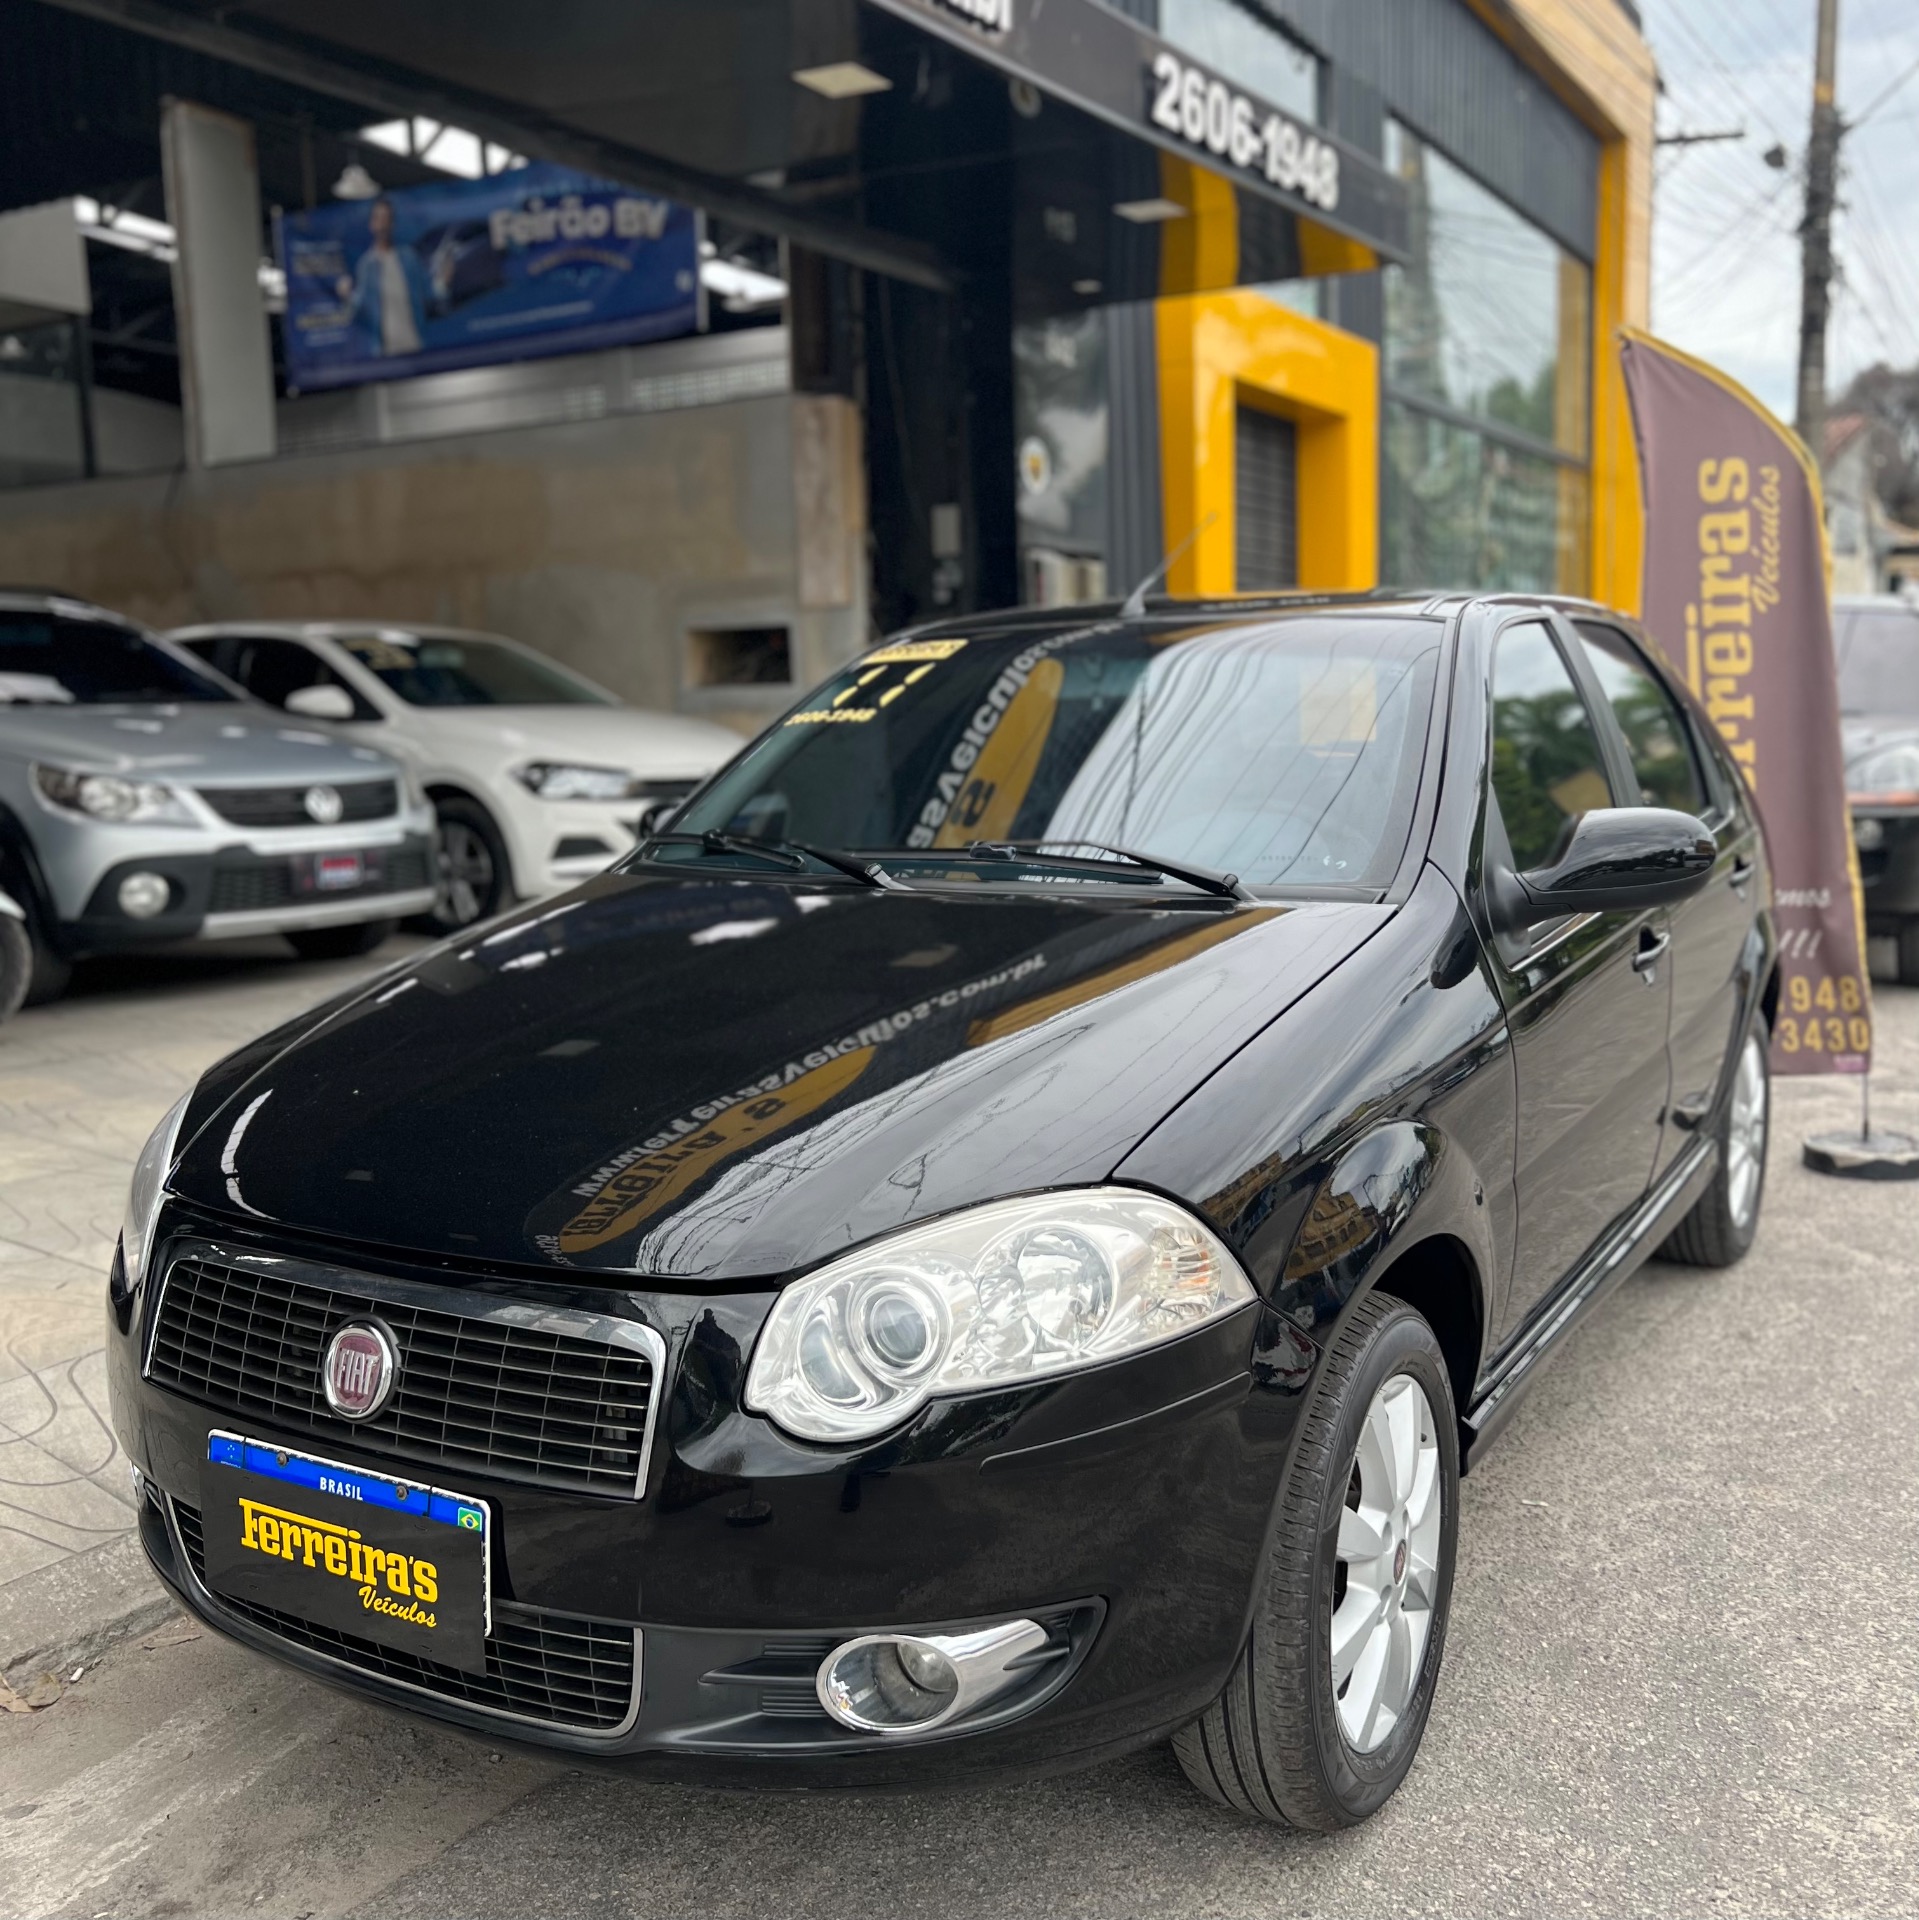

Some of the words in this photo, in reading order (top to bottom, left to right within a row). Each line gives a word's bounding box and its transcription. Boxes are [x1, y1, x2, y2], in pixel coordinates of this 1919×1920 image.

[1152, 53, 1339, 211] 2606-1948
[488, 196, 611, 250] Feirão
[613, 198, 669, 240] BV
[337, 1348, 379, 1395] FIAT
[319, 1476, 363, 1501] BRASIL
[358, 1586, 437, 1628] Veículos
